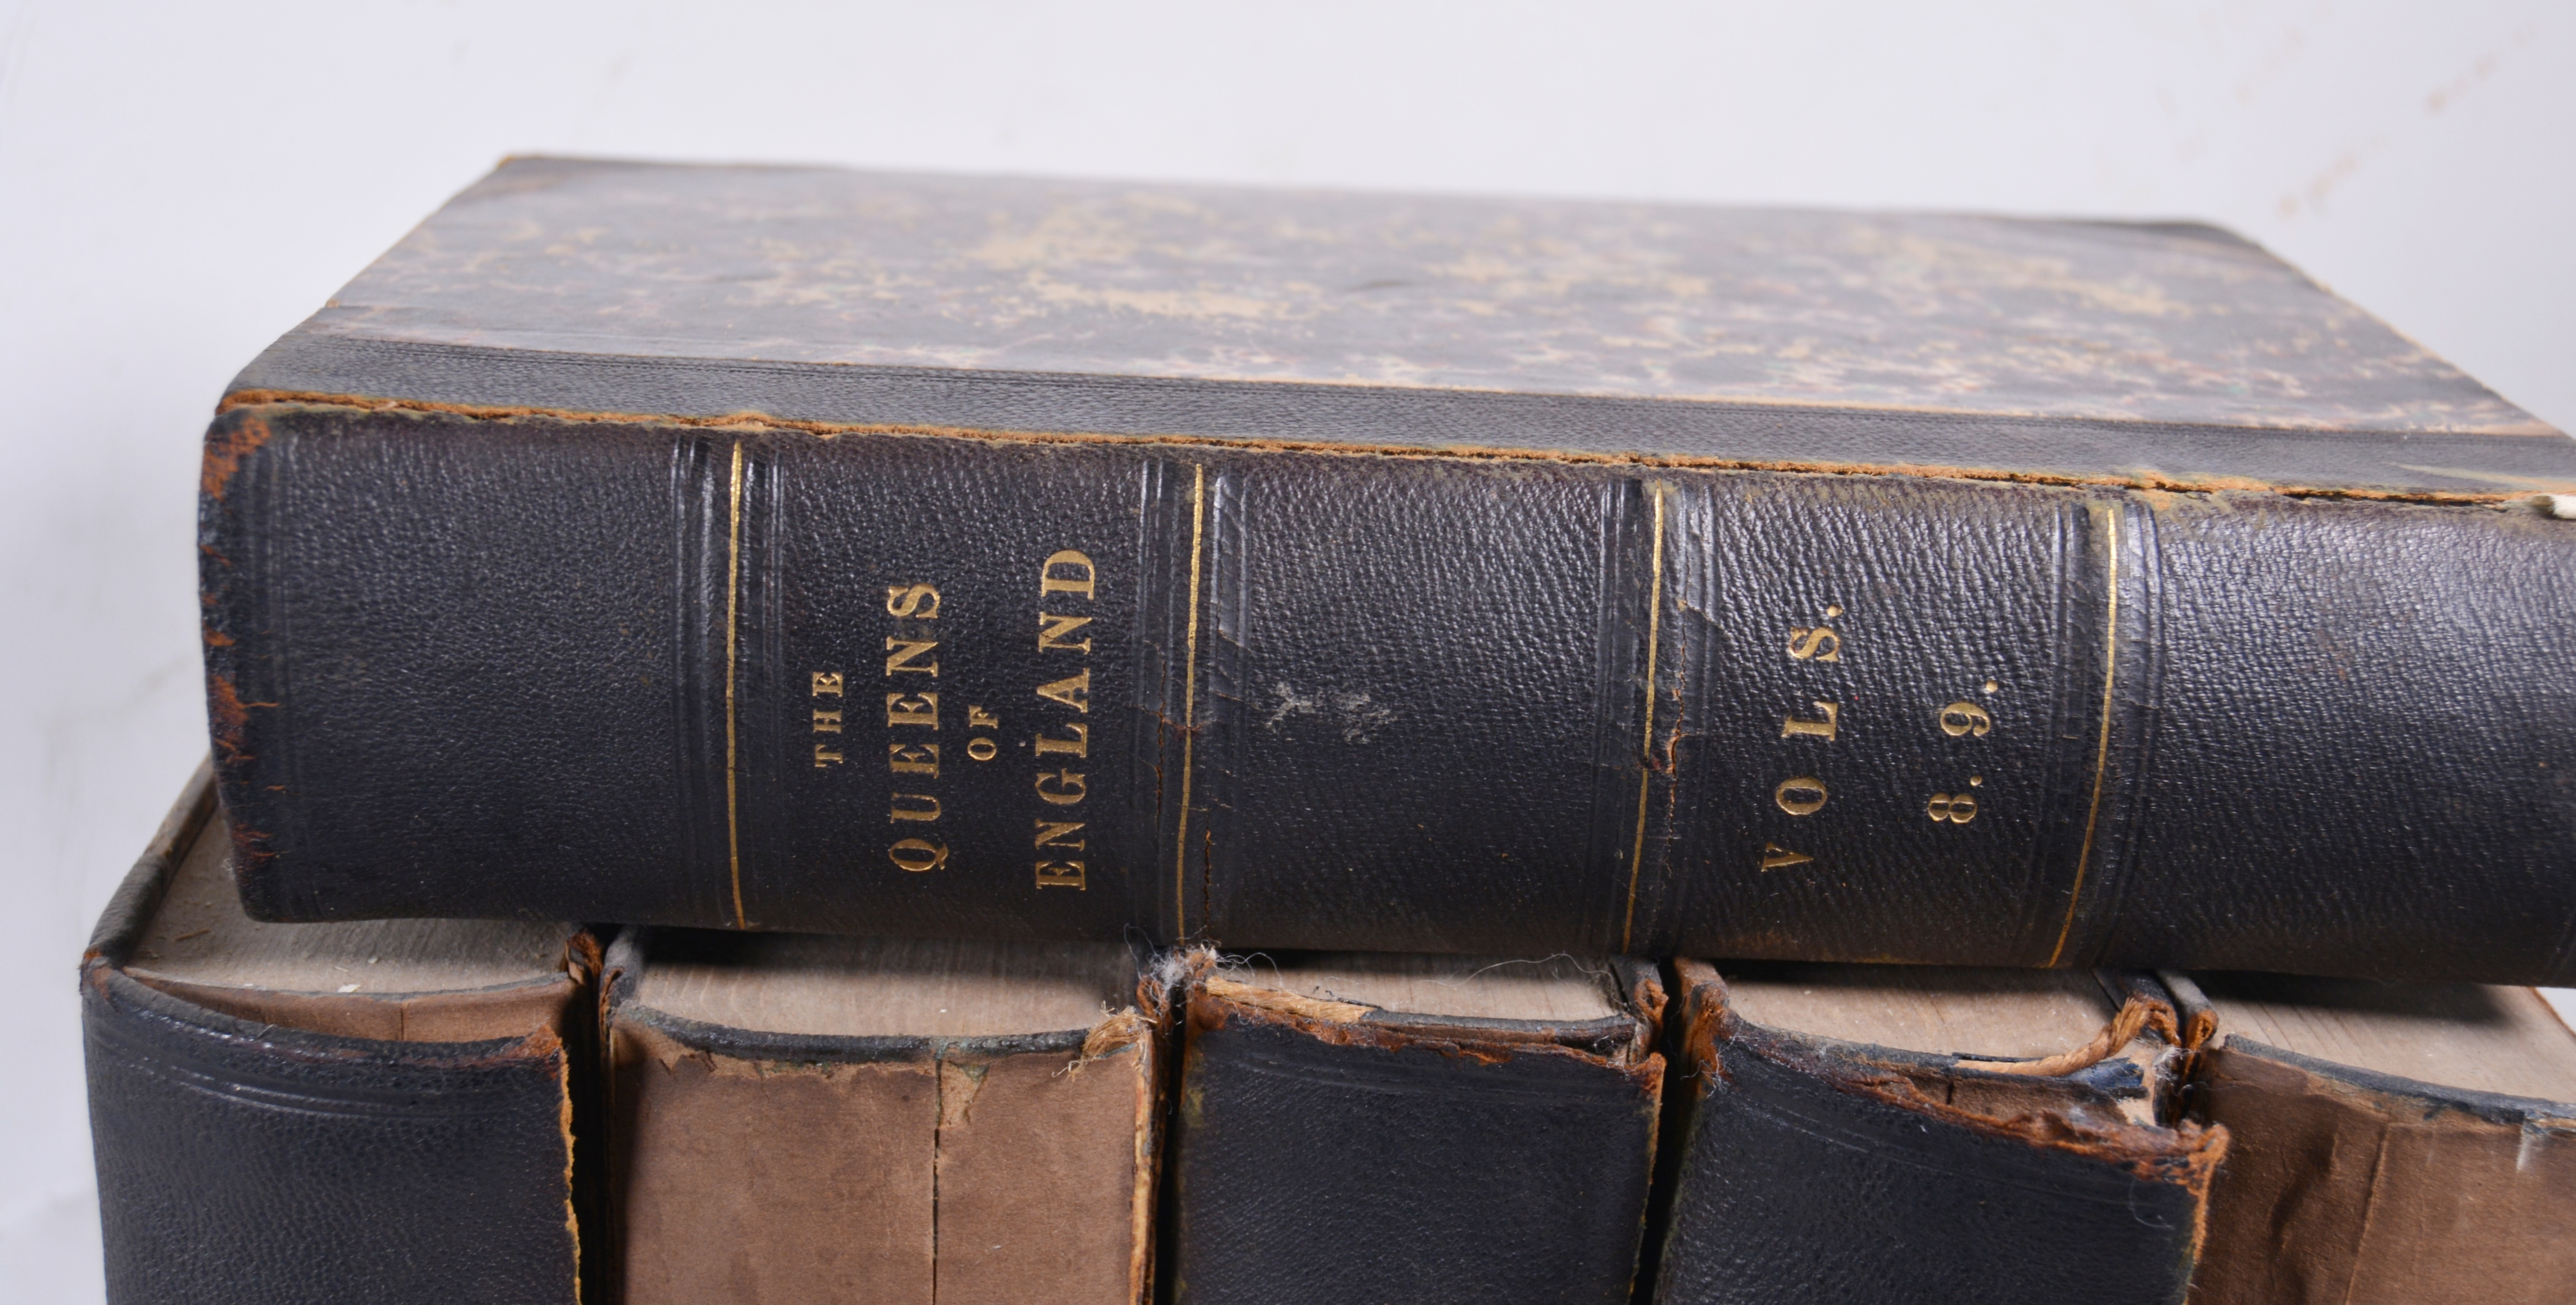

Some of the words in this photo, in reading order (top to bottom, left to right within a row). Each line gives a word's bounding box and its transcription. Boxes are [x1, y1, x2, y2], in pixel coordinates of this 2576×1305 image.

[812, 671, 843, 768] THE
[886, 583, 948, 872] QUEENS
[967, 704, 998, 761] OF
[1034, 549, 1096, 890] ENGLAND
[1761, 603, 1843, 872] VOLS.
[1940, 679, 1998, 737] 9.
[1928, 775, 1982, 824] 8.
